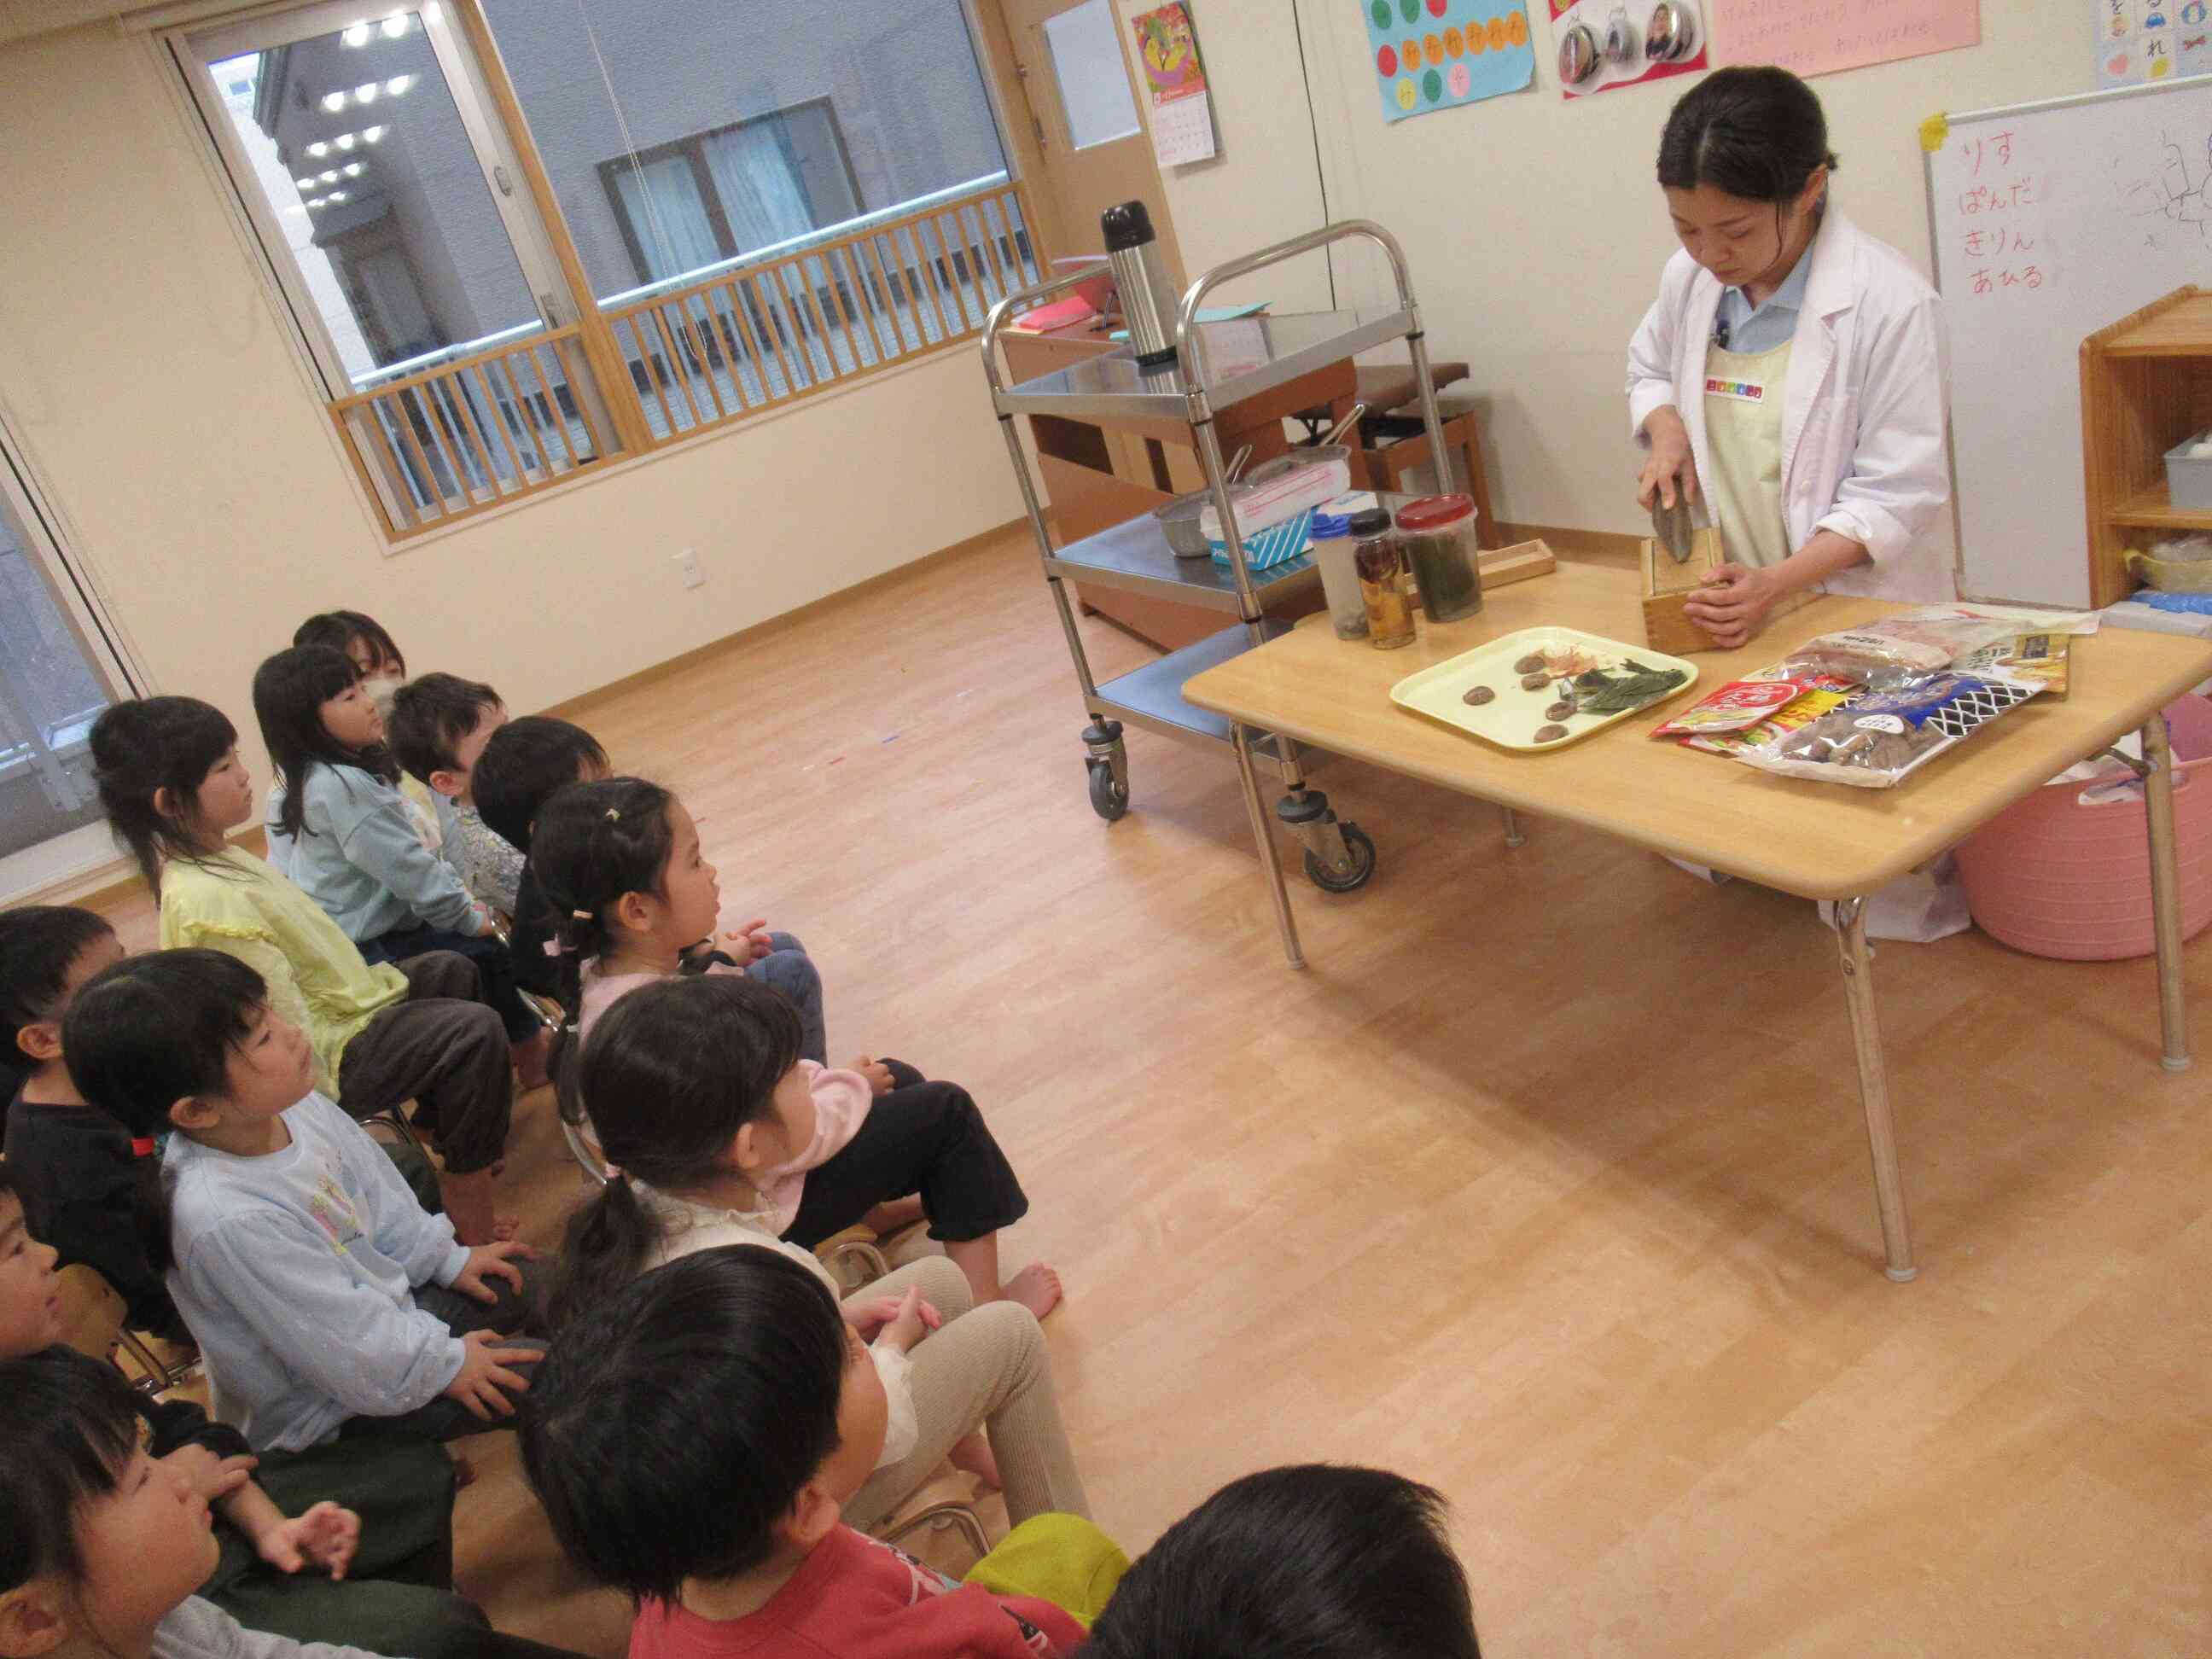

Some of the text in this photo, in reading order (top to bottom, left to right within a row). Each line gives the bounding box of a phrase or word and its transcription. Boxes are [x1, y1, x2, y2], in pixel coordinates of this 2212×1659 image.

[1965, 131, 2014, 177] りす
[1959, 177, 2035, 215] ぱんだ
[1965, 228, 2034, 256] きりん
